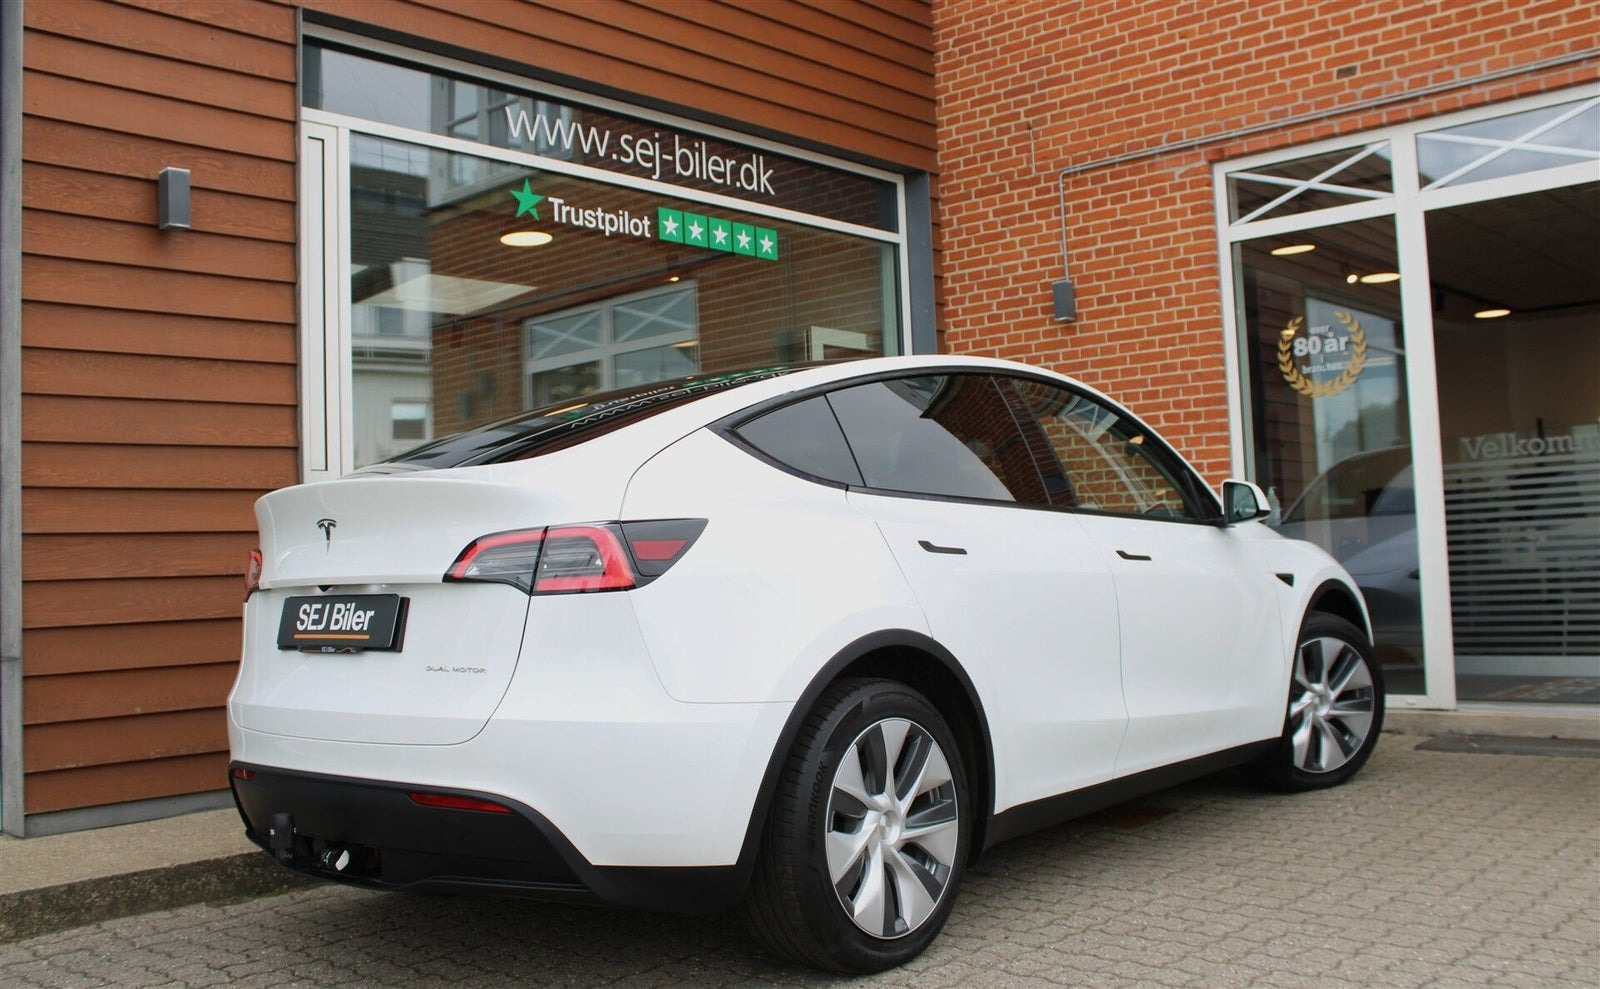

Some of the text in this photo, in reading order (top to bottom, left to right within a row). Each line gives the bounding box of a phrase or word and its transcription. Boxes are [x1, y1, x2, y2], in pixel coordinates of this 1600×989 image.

[505, 105, 776, 196] www.sej-biler.dk
[548, 196, 651, 238] Trustpilot
[1293, 331, 1349, 357] 80 år
[296, 602, 375, 632] SEJ Biler
[425, 665, 450, 673] DUAL
